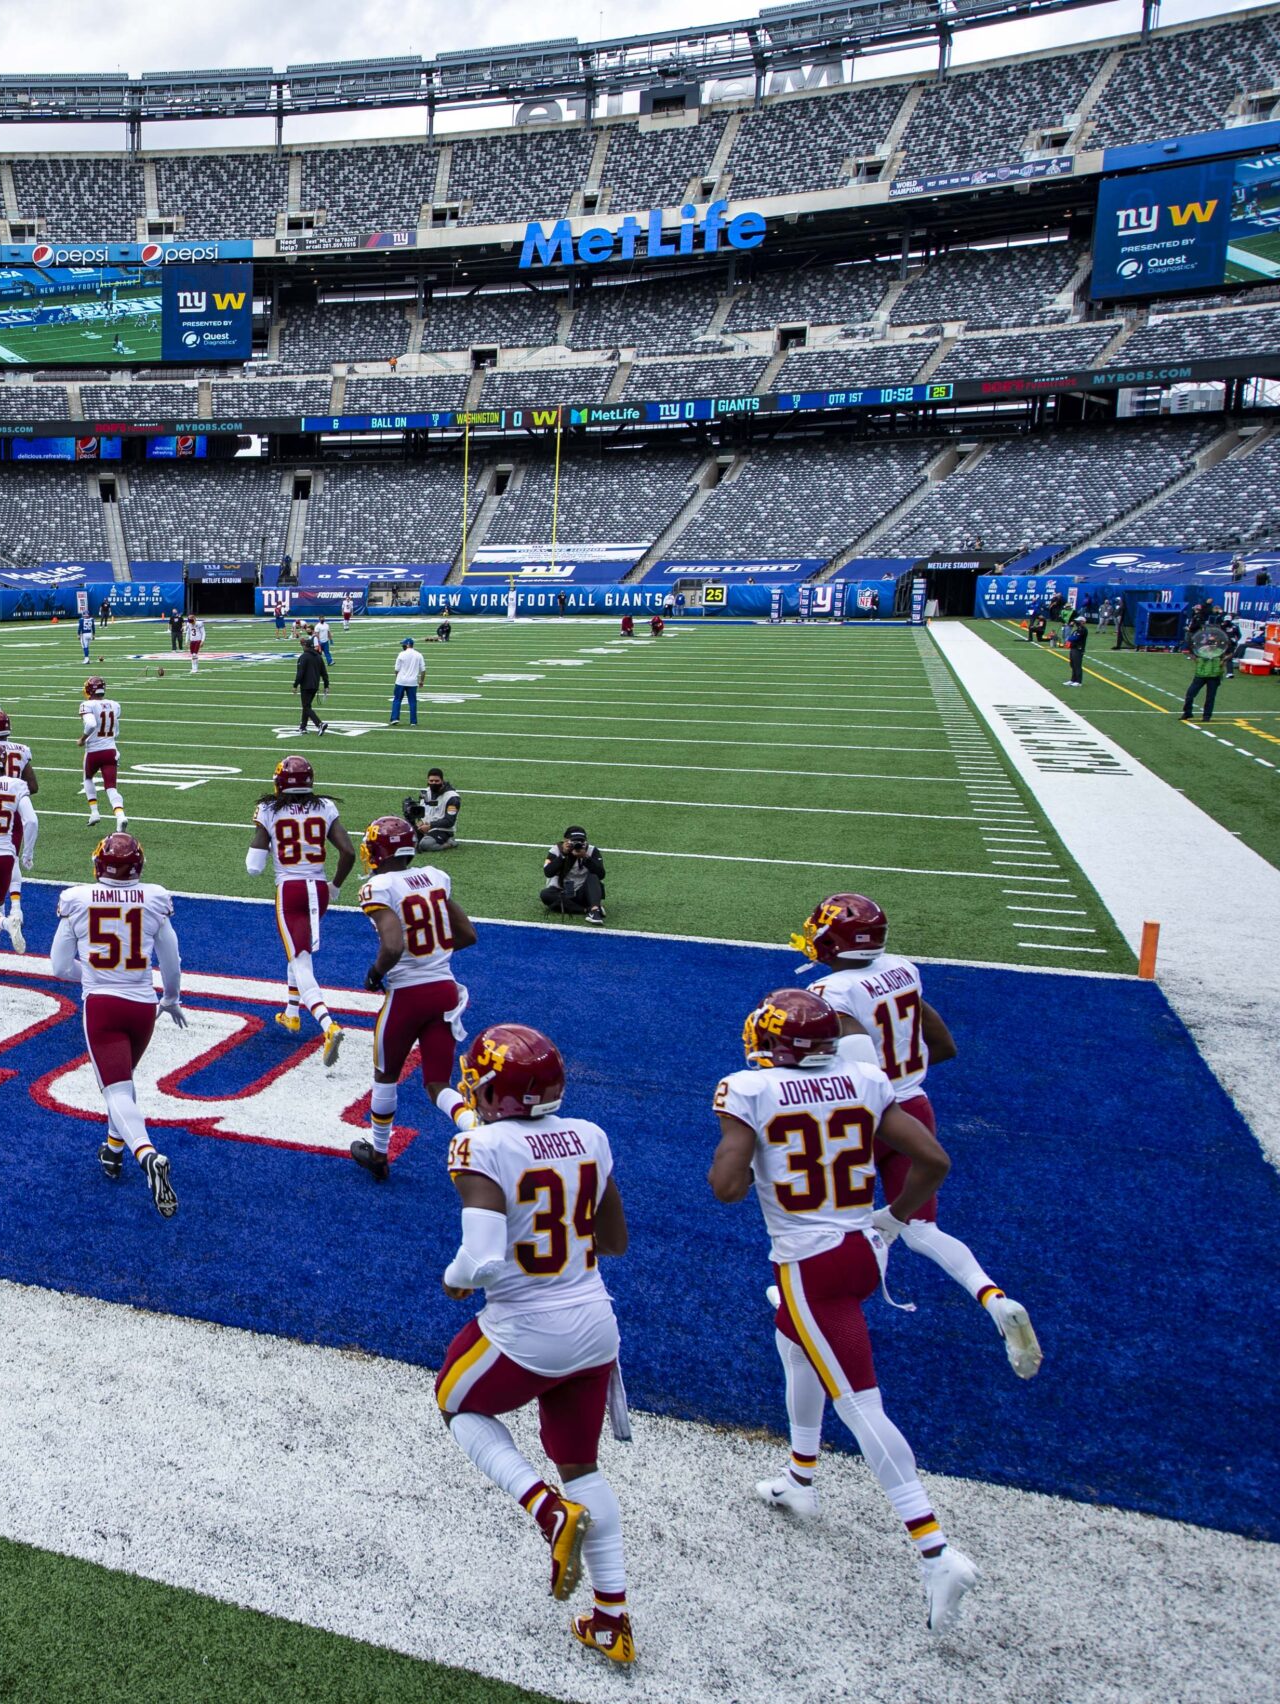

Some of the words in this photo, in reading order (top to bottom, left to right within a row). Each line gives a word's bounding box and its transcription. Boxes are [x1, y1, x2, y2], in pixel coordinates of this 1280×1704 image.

[889, 186, 924, 197] CHAMPIONS
[896, 180, 918, 189] WORLD
[1116, 206, 1159, 236] ny
[1167, 199, 1218, 227] W
[393, 233, 409, 246] ny
[518, 199, 767, 269] MetLife
[165, 243, 219, 264] pepsi
[1121, 240, 1180, 253] PRESENTED
[1181, 238, 1195, 246] BY
[56, 246, 109, 266] pepsi
[1148, 255, 1187, 268] Quest
[1148, 264, 1195, 274] Diagnostics
[177, 291, 207, 313] ny
[211, 292, 247, 310] W
[203, 332, 229, 340] Quest
[1092, 367, 1192, 385] MYBOBS.COM
[829, 393, 845, 405] QTR
[880, 387, 914, 403] 10:52
[933, 386, 946, 398] 25
[659, 403, 680, 420] ny
[685, 401, 694, 419] 0
[718, 397, 759, 412] GIANTS
[372, 417, 391, 428] BALL
[395, 417, 407, 427] ON
[457, 412, 499, 425] WASHINGTON
[513, 410, 523, 428] 0
[532, 410, 558, 426] W
[591, 408, 641, 421] MetLife
[176, 422, 243, 432] MYBOBS.COM
[0, 565, 85, 580] MetLife
[729, 564, 796, 573] LIGHT
[32, 573, 87, 585] Stadium
[262, 590, 290, 613] ny
[428, 593, 461, 607] NEW
[470, 592, 508, 607] YORK
[605, 592, 663, 607] GIANTS
[706, 588, 723, 601] 25
[191, 628, 197, 637] 3
[96, 710, 115, 737] 11
[289, 802, 310, 816] SIMS
[274, 816, 327, 866] 89
[403, 873, 433, 890] INMAN
[91, 889, 145, 904] HAMILTON
[401, 887, 456, 957] 80
[817, 904, 843, 927] 17
[88, 906, 148, 971] 51
[859, 966, 915, 1000] McLAURIN
[758, 1003, 789, 1036] 32
[872, 989, 926, 1082] 17
[476, 1038, 510, 1073] 34
[778, 1075, 858, 1107] JOHNSON
[524, 1130, 588, 1161] BARBER
[764, 1105, 877, 1215] 32
[513, 1160, 601, 1278] 34
